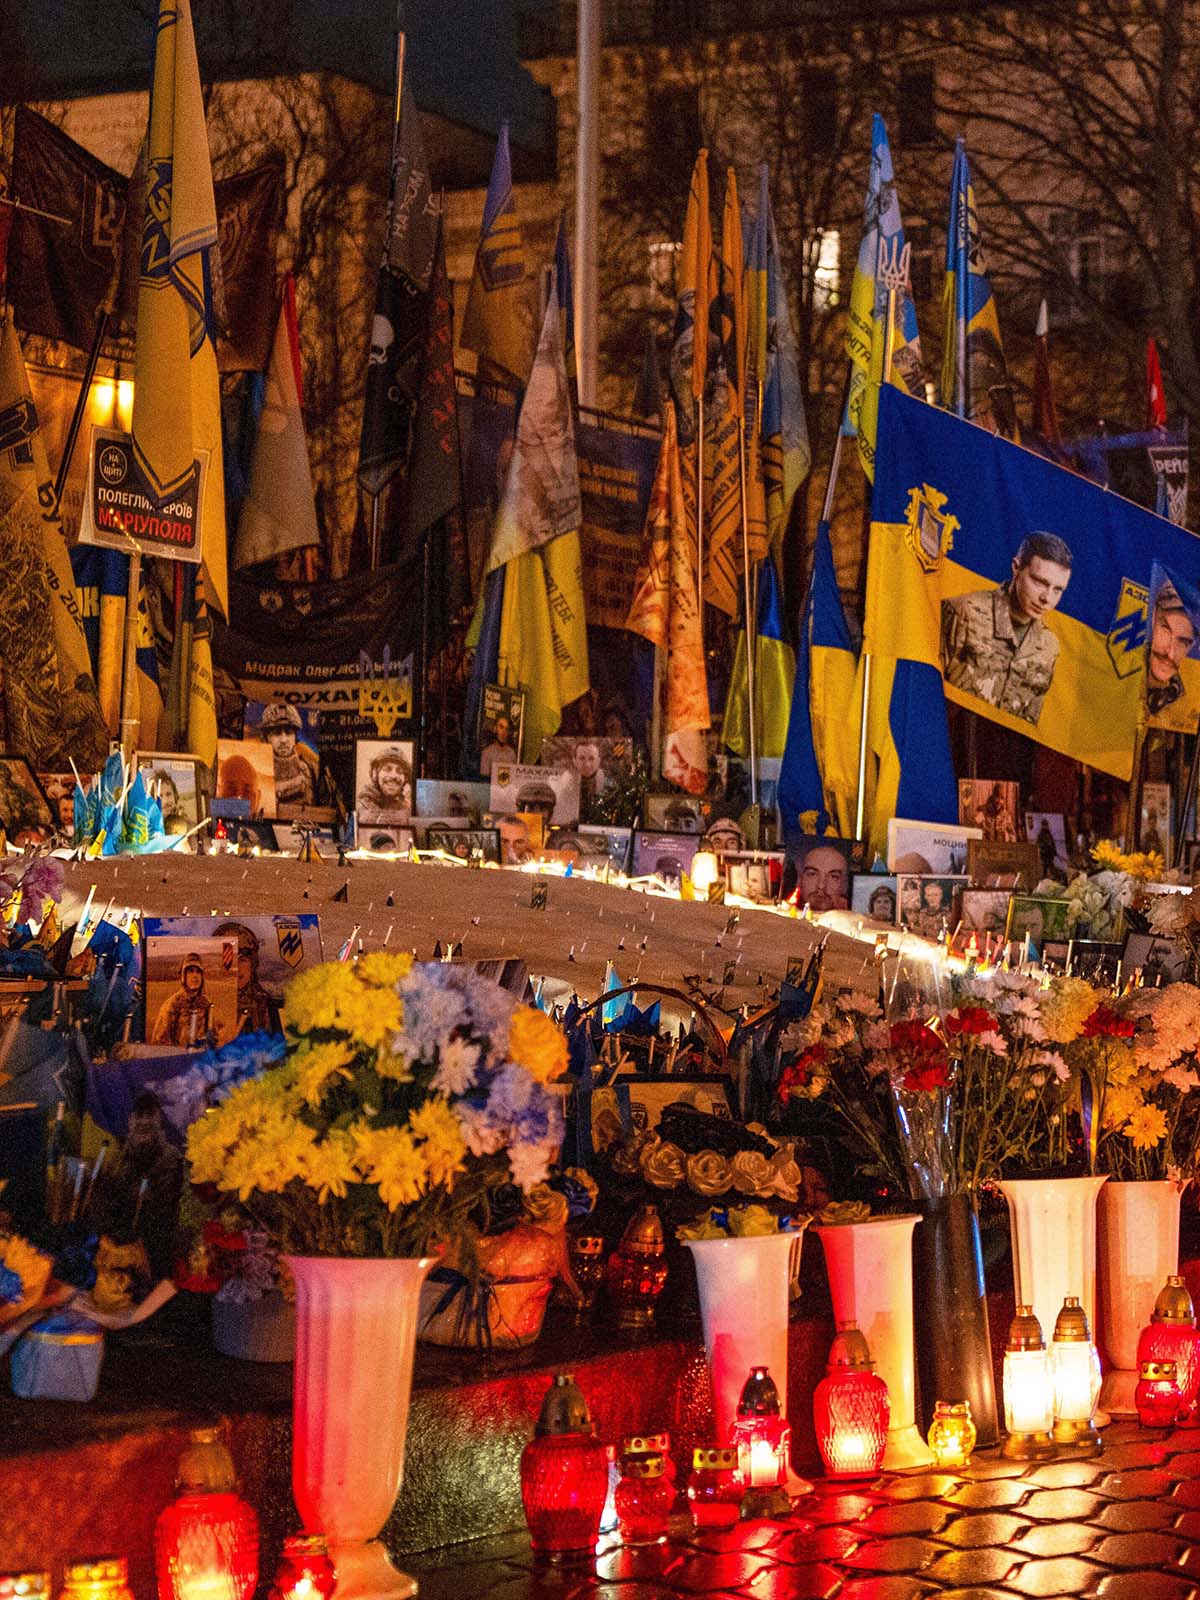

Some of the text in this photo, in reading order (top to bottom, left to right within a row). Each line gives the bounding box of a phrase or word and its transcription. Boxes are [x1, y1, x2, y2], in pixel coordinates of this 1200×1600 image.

[98, 487, 193, 519] ПОЛЕГЛИ ЕРОЇВ
[98, 506, 192, 543] МАРІУПОЛЯ
[245, 661, 300, 677] Мудрак
[305, 664, 336, 677] Олег
